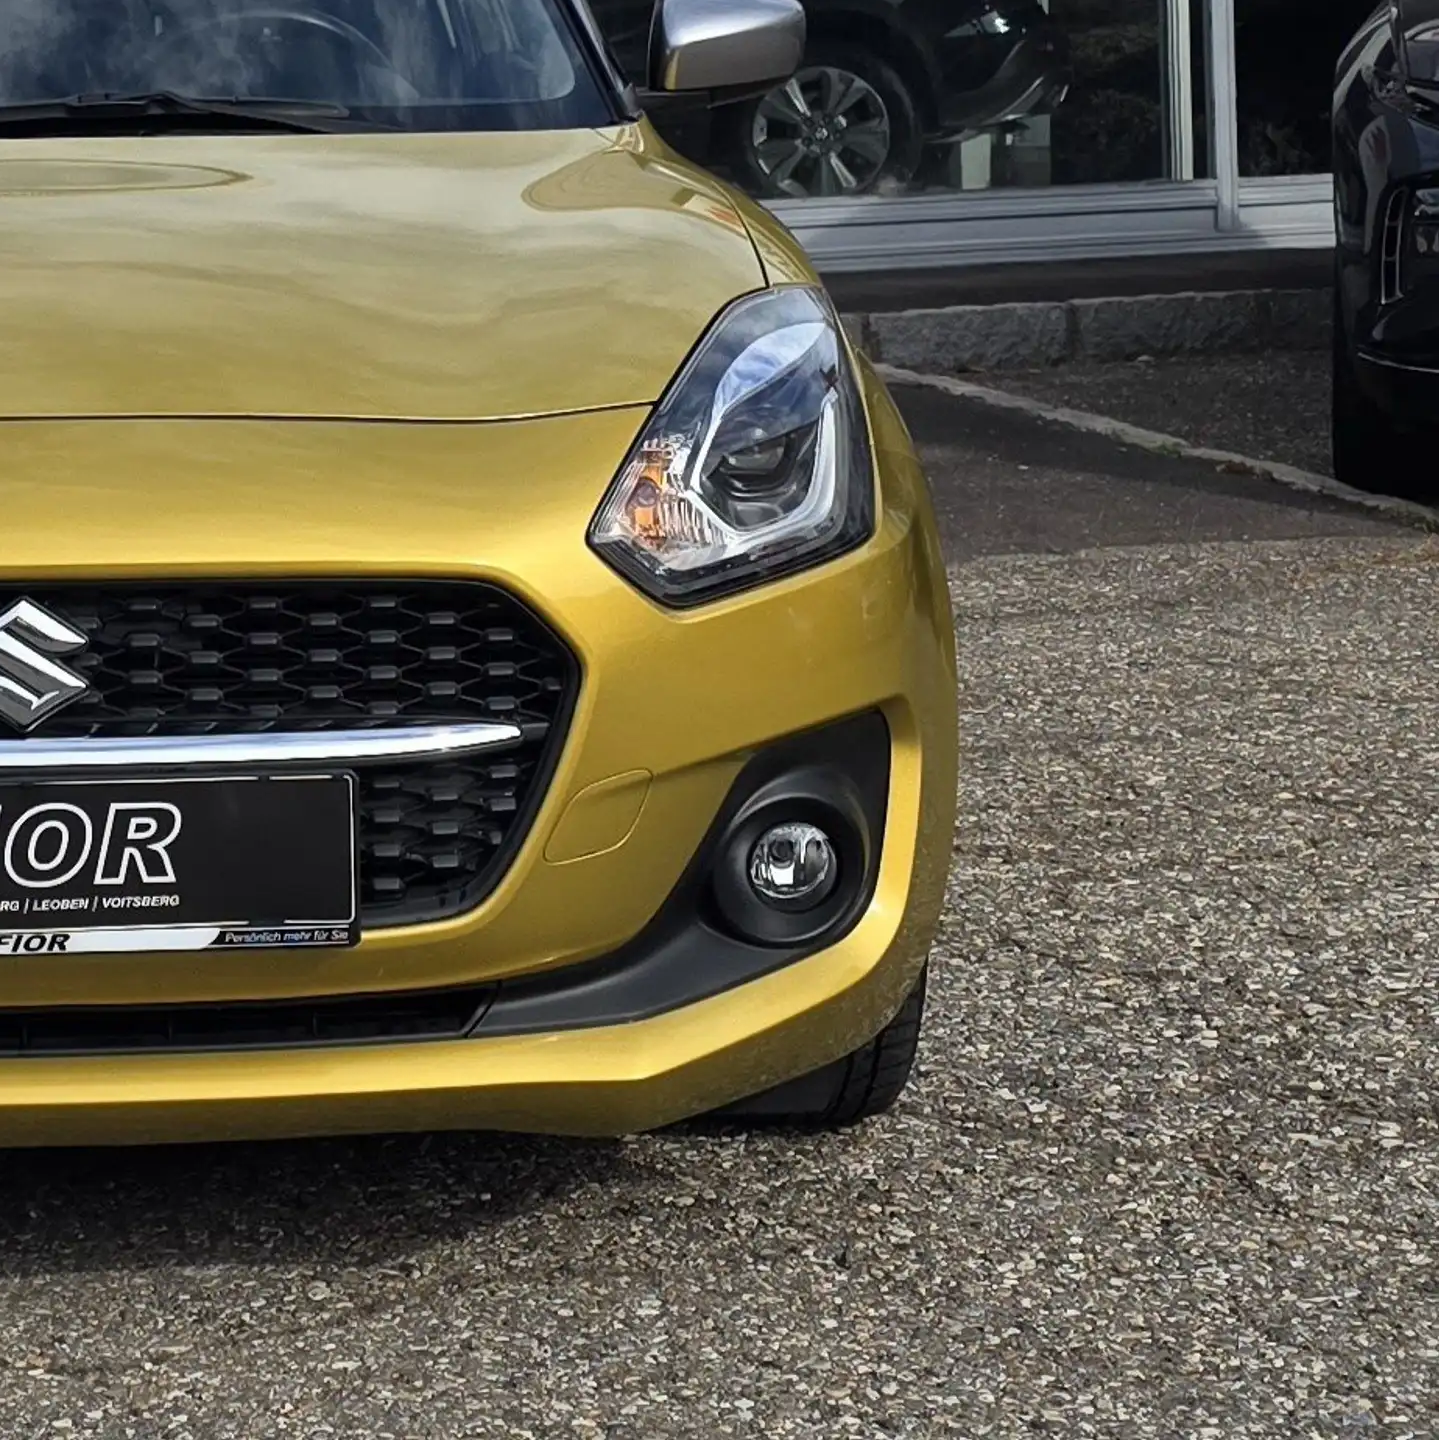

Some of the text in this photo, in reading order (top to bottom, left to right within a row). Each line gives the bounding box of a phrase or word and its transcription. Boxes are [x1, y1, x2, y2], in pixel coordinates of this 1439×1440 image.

[32, 898, 89, 912] LEOBEN
[101, 894, 180, 909] VOITSBERG
[283, 930, 311, 941] mehr
[313, 929, 329, 942] für
[331, 929, 349, 940] Sie
